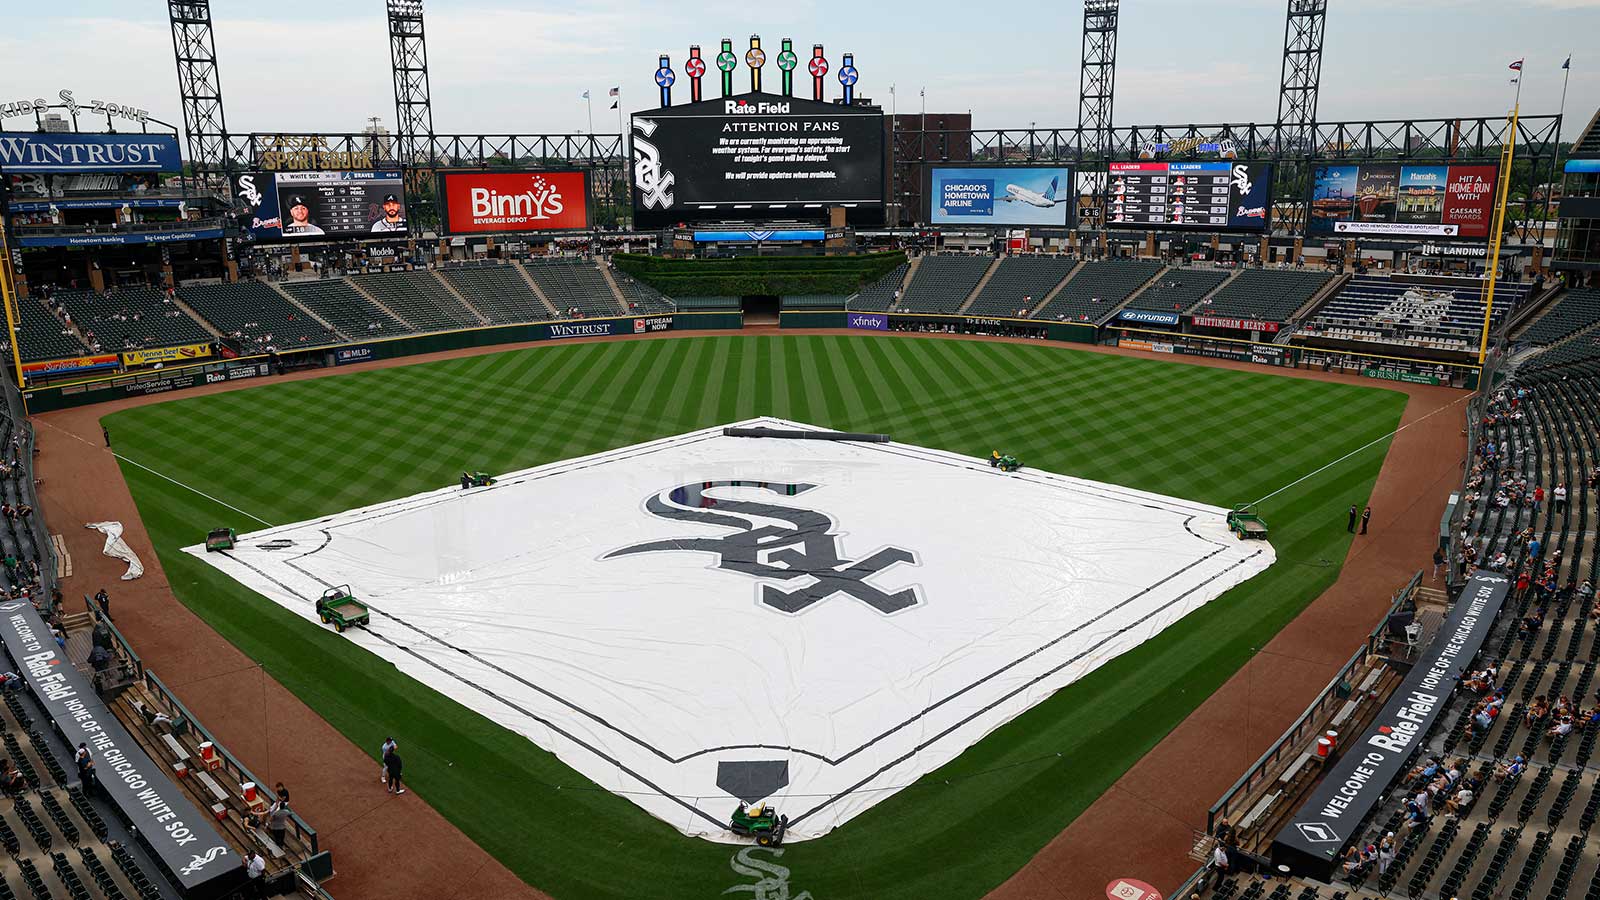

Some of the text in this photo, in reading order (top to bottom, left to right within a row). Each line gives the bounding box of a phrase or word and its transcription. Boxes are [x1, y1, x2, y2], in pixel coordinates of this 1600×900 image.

[0, 98, 49, 119] KIDS
[91, 99, 150, 124] ZONE
[725, 100, 790, 114] Rate Field
[722, 122, 840, 132] ATTENTION FANS
[263, 136, 327, 147] CAESARS
[719, 137, 729, 145] We
[739, 138, 767, 146] currently
[767, 138, 799, 146] monitoring
[807, 137, 843, 146] approaching
[712, 146, 737, 154] weather
[771, 146, 803, 154] everyone's
[804, 146, 824, 154] safety,
[824, 145, 834, 153] the
[264, 151, 373, 169] SPORTSBOOK
[741, 155, 767, 163] tonight's
[804, 154, 829, 163] delayed.
[725, 172, 735, 180] We
[735, 172, 746, 180] will
[746, 172, 768, 181] provide
[769, 172, 792, 180] updates
[809, 171, 837, 179] available.
[1458, 175, 1474, 183] HIT
[944, 184, 987, 192] CHICAGO'S
[1449, 183, 1491, 193] HOME RUN
[1456, 193, 1480, 201] WITH
[944, 199, 972, 207] AIRLINE
[102, 236, 125, 244] Banking
[370, 247, 395, 256] Modelo
[1443, 247, 1485, 256] LANDING
[852, 316, 882, 328] xfinity
[1135, 313, 1174, 322] HYUNDAI
[1194, 316, 1266, 331] WHITTINGHAM MEATS
[550, 324, 611, 336] WINTRUST
[1252, 355, 1268, 363] Rate
[206, 372, 226, 383] Rate
[1377, 371, 1399, 380] RUSH
[126, 379, 171, 392] UnitedService
[9, 613, 42, 653] WELCOME TO
[1420, 585, 1494, 690] HOME OF THE CHICAGO WHITE SOX
[22, 650, 77, 703] Rate Field
[1367, 691, 1439, 753] Rate Field
[64, 698, 197, 847] HOME OF THE CHICAGO WHITE SOX
[1321, 752, 1385, 819] WELCOME TO
